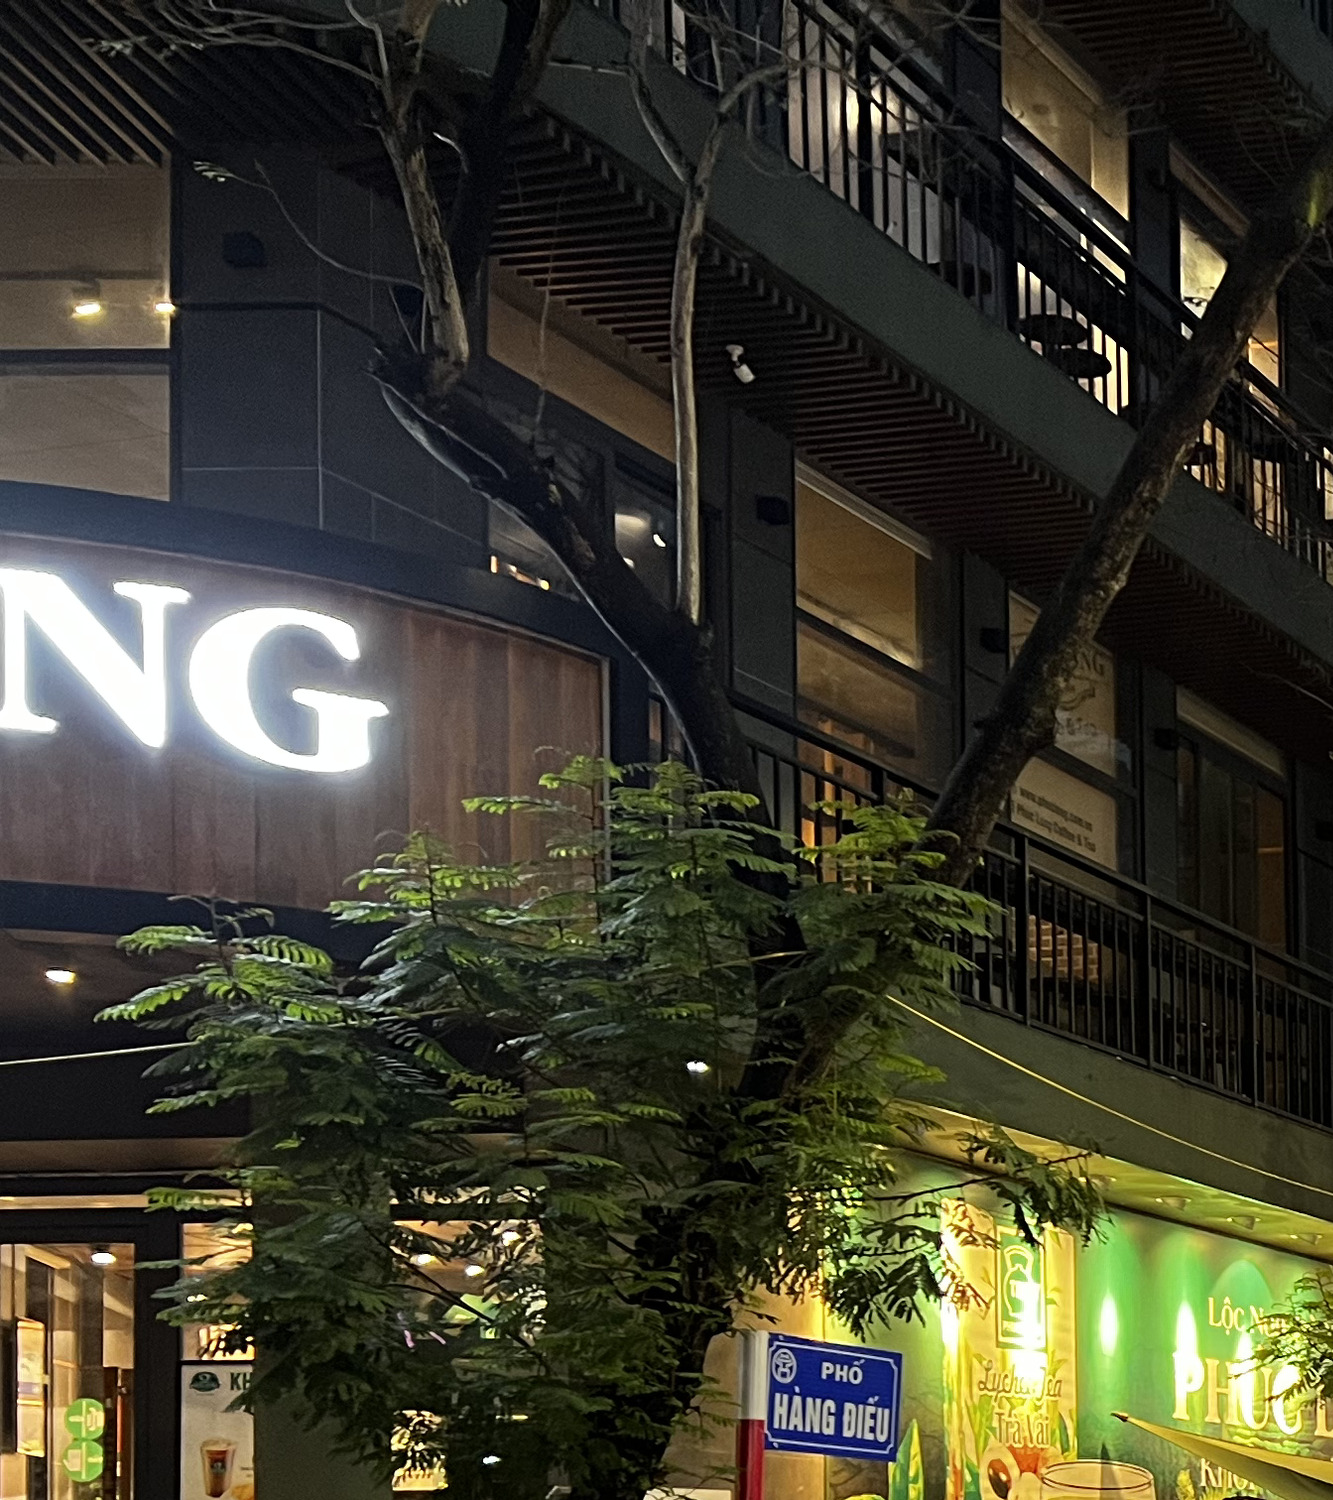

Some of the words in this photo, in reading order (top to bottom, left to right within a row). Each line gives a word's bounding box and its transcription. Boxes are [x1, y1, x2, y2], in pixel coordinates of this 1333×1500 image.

[820, 1358, 865, 1385] PHỐ
[772, 1385, 837, 1436] HÀNG
[842, 1395, 891, 1443] ĐIẾU
